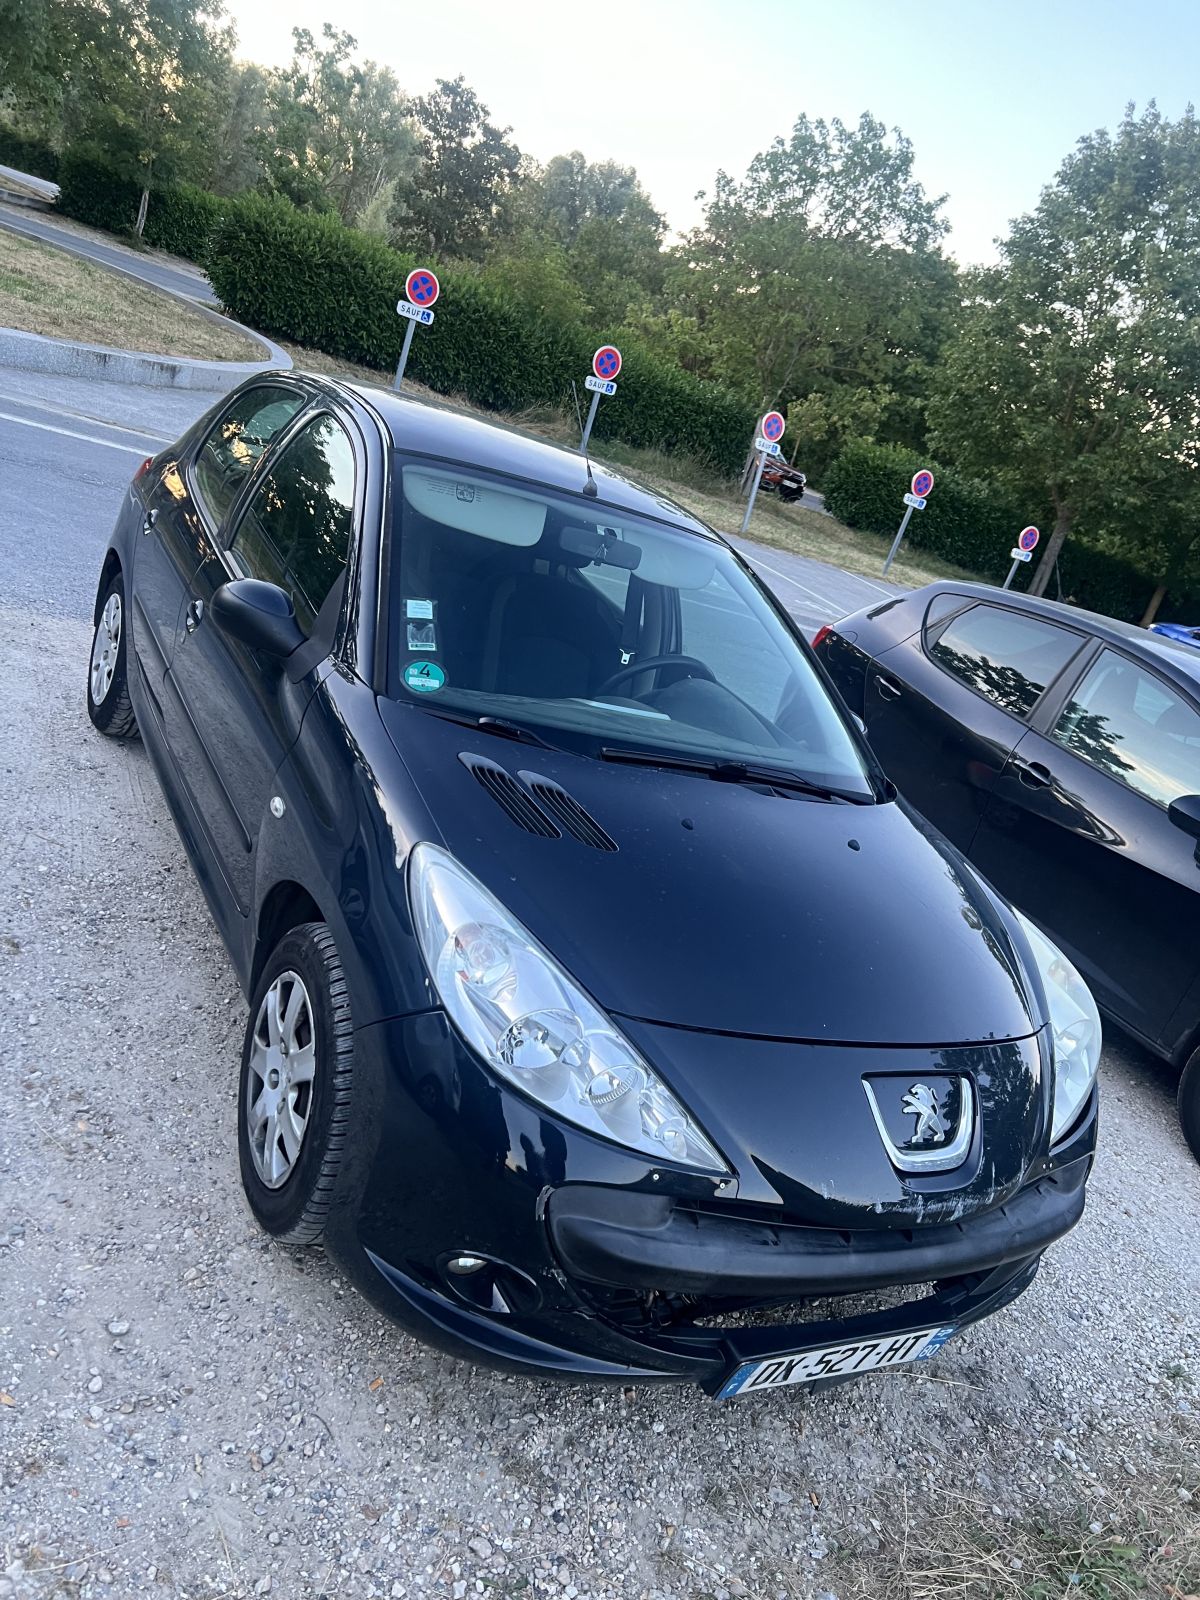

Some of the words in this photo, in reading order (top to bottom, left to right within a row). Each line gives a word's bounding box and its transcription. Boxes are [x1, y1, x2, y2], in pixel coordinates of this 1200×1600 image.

[400, 304, 421, 317] SAUF
[588, 379, 606, 390] SAUF
[419, 663, 431, 678] 4
[918, 1343, 941, 1358] 80
[748, 1333, 929, 1389] DX-527-HT
[726, 1382, 735, 1393] F
